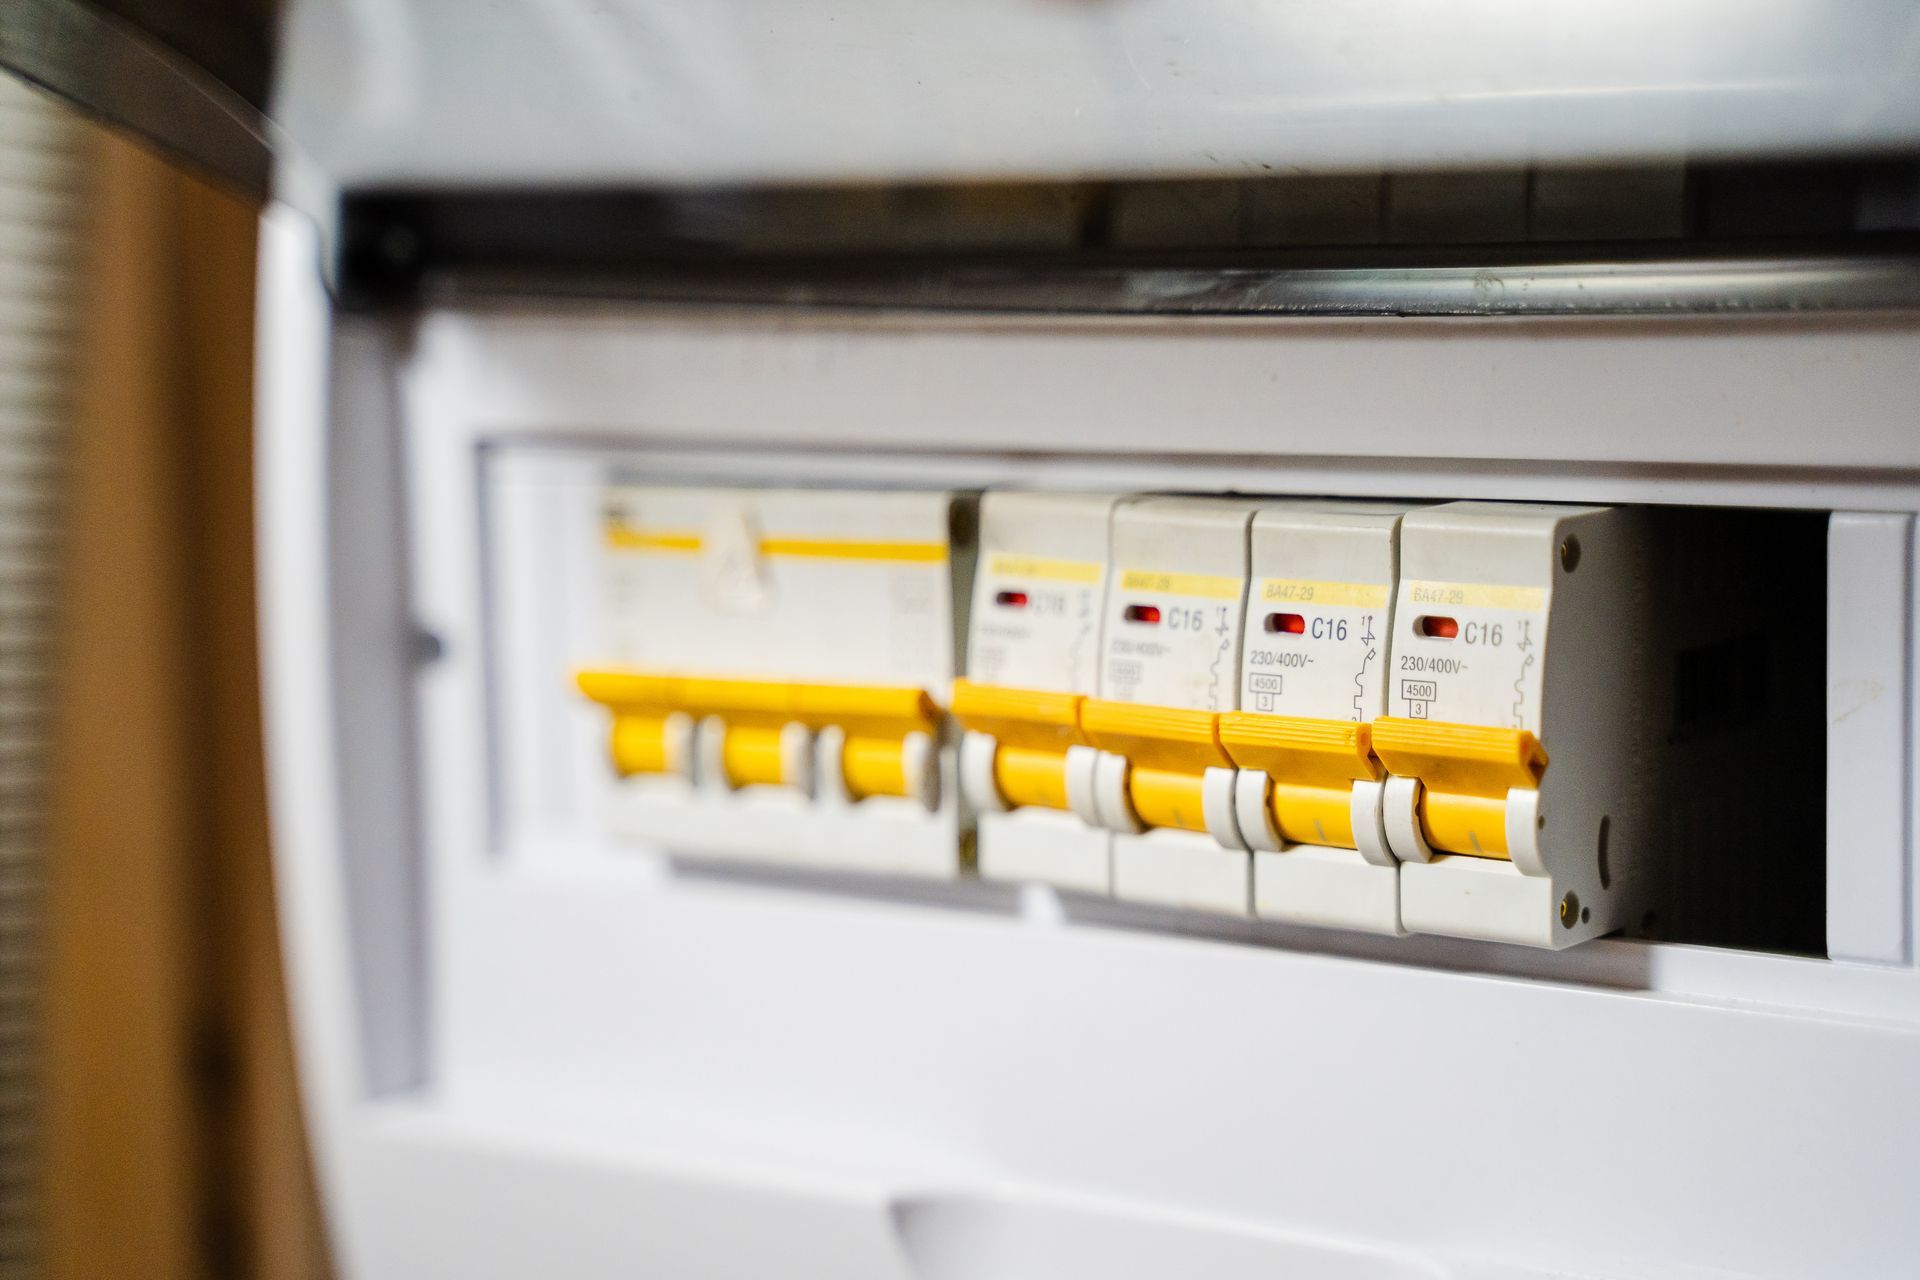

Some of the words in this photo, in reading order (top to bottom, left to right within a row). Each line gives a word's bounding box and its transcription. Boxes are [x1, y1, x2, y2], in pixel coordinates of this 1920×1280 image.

[1168, 606, 1203, 632] C16
[1311, 617, 1348, 641] C16
[1465, 621, 1503, 647] C16
[1254, 677, 1278, 691] 4500
[1406, 684, 1432, 698] 4500
[1261, 696, 1268, 708] 3
[1415, 703, 1422, 715] 3
